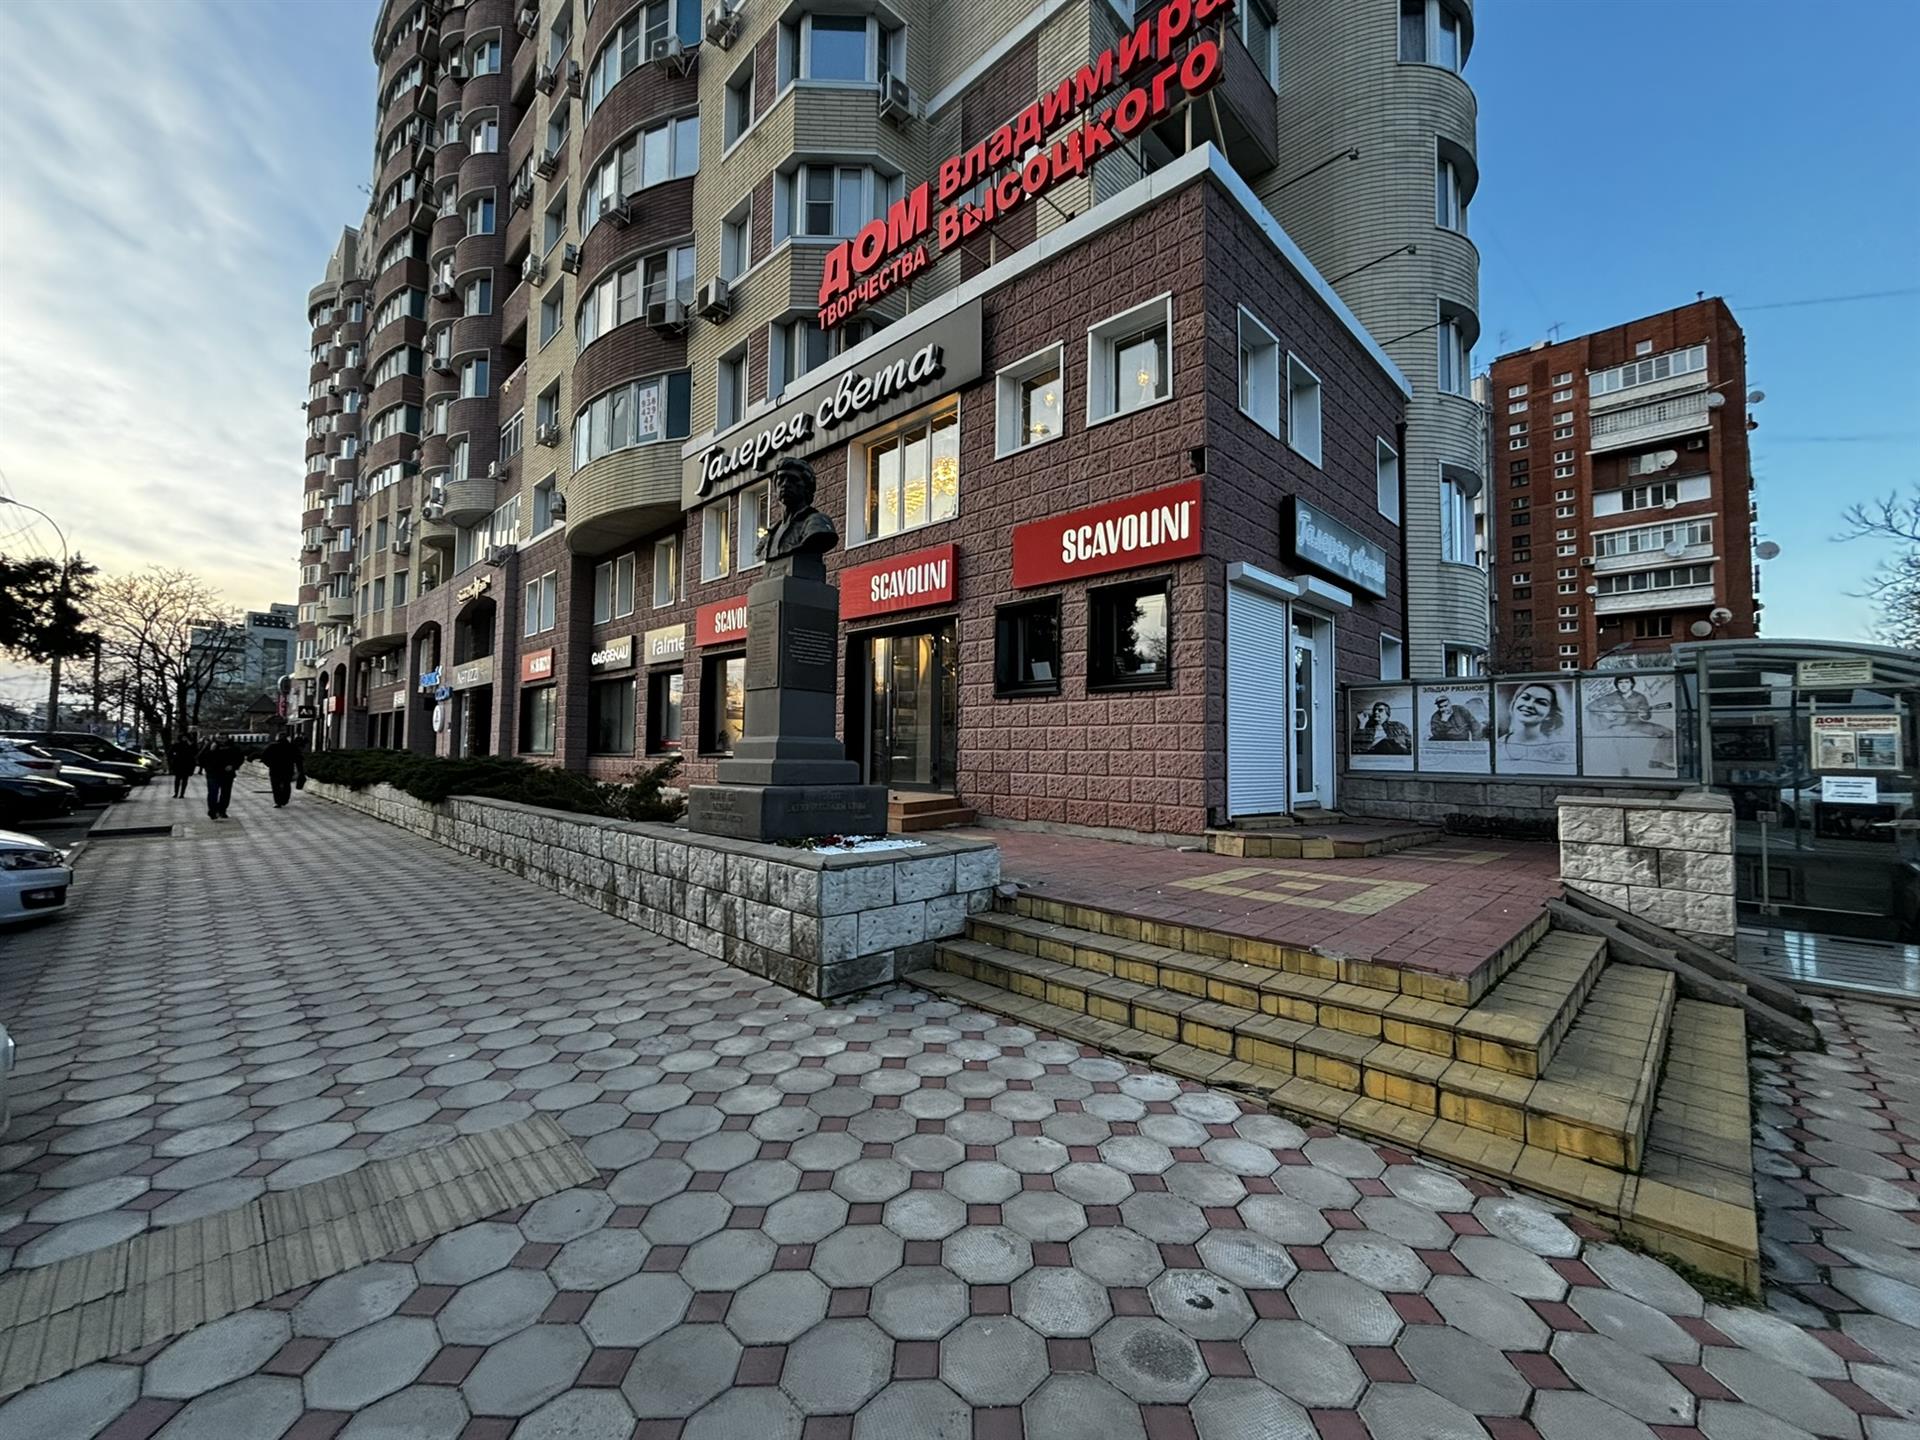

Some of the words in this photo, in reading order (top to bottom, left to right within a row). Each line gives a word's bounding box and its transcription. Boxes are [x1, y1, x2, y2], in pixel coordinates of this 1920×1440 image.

[939, 40, 1221, 252] Высоцкого
[818, 183, 931, 306] ДОМ
[818, 246, 927, 331] ТВОРЧЕСТВА
[694, 411, 807, 496] Галерея
[816, 343, 939, 429] света
[1061, 501, 1190, 564] SCAVOLINI
[1296, 510, 1350, 566] Галерея
[870, 559, 947, 602] SCAVOLINI
[591, 644, 629, 666] GAGGENAU
[1451, 685, 1486, 693] РЯЗАНОВ
